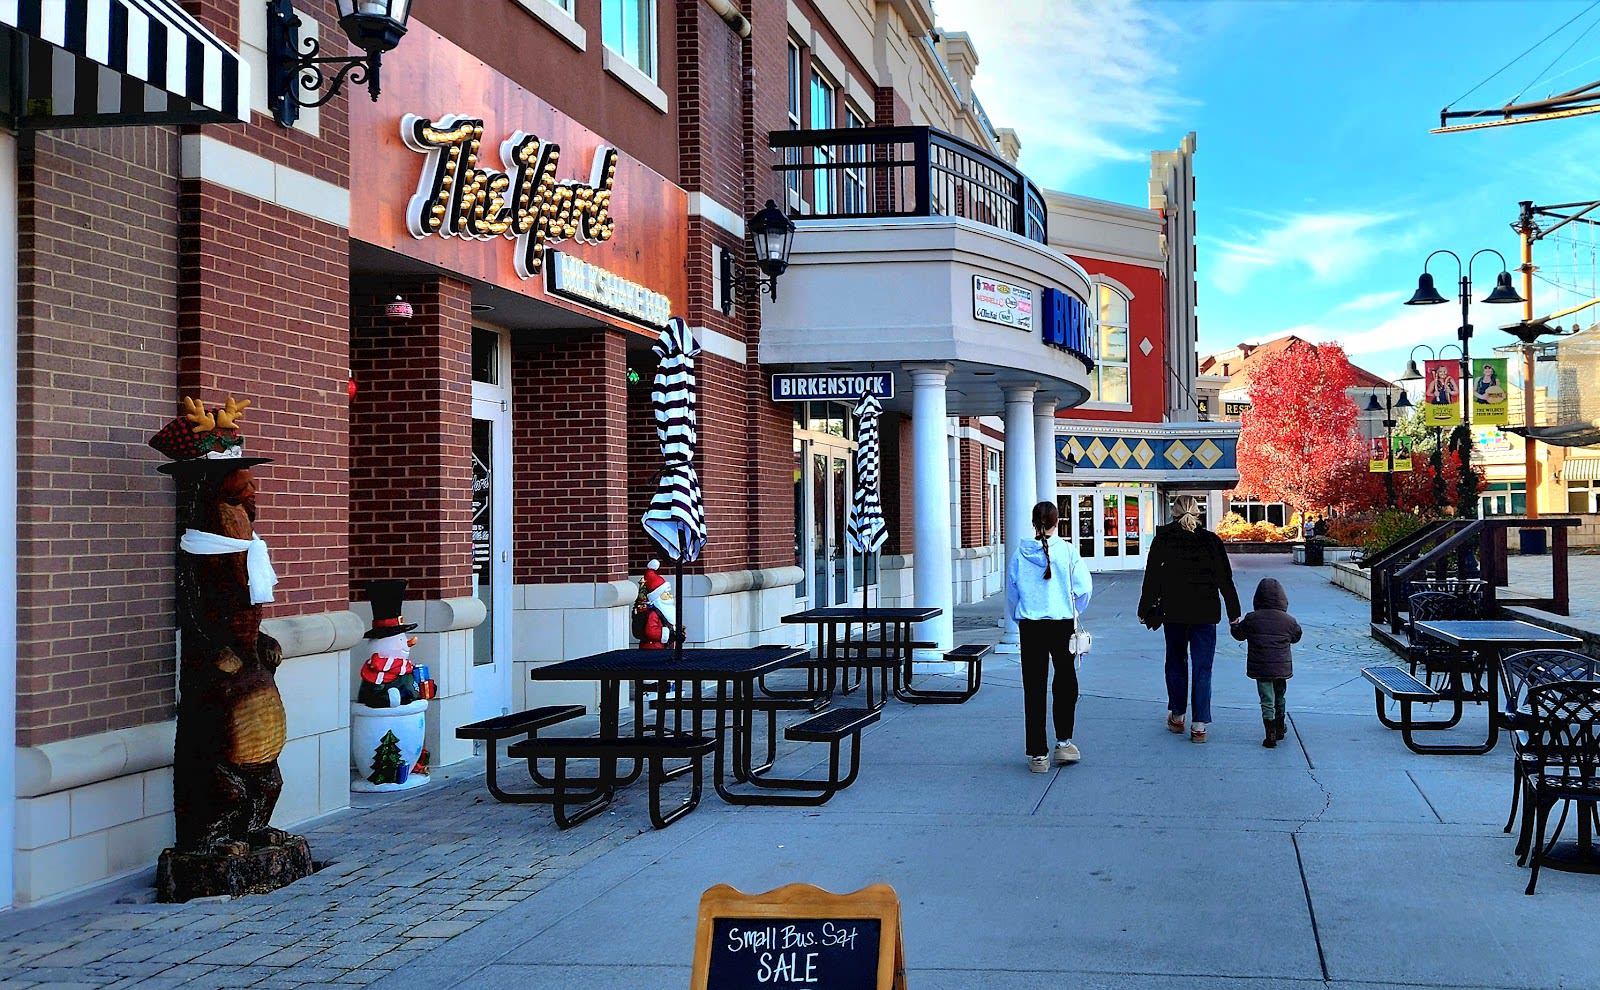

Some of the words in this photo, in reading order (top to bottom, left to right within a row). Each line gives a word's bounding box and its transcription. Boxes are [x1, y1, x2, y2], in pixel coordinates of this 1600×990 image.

[402, 113, 512, 240] The
[501, 131, 618, 279] Yard
[780, 376, 884, 396] BIRKENSTOCK
[1199, 402, 1207, 411] &
[728, 927, 776, 953] Small
[780, 925, 818, 950] Bus.
[822, 922, 858, 950] Sat
[757, 952, 819, 983] SALE
